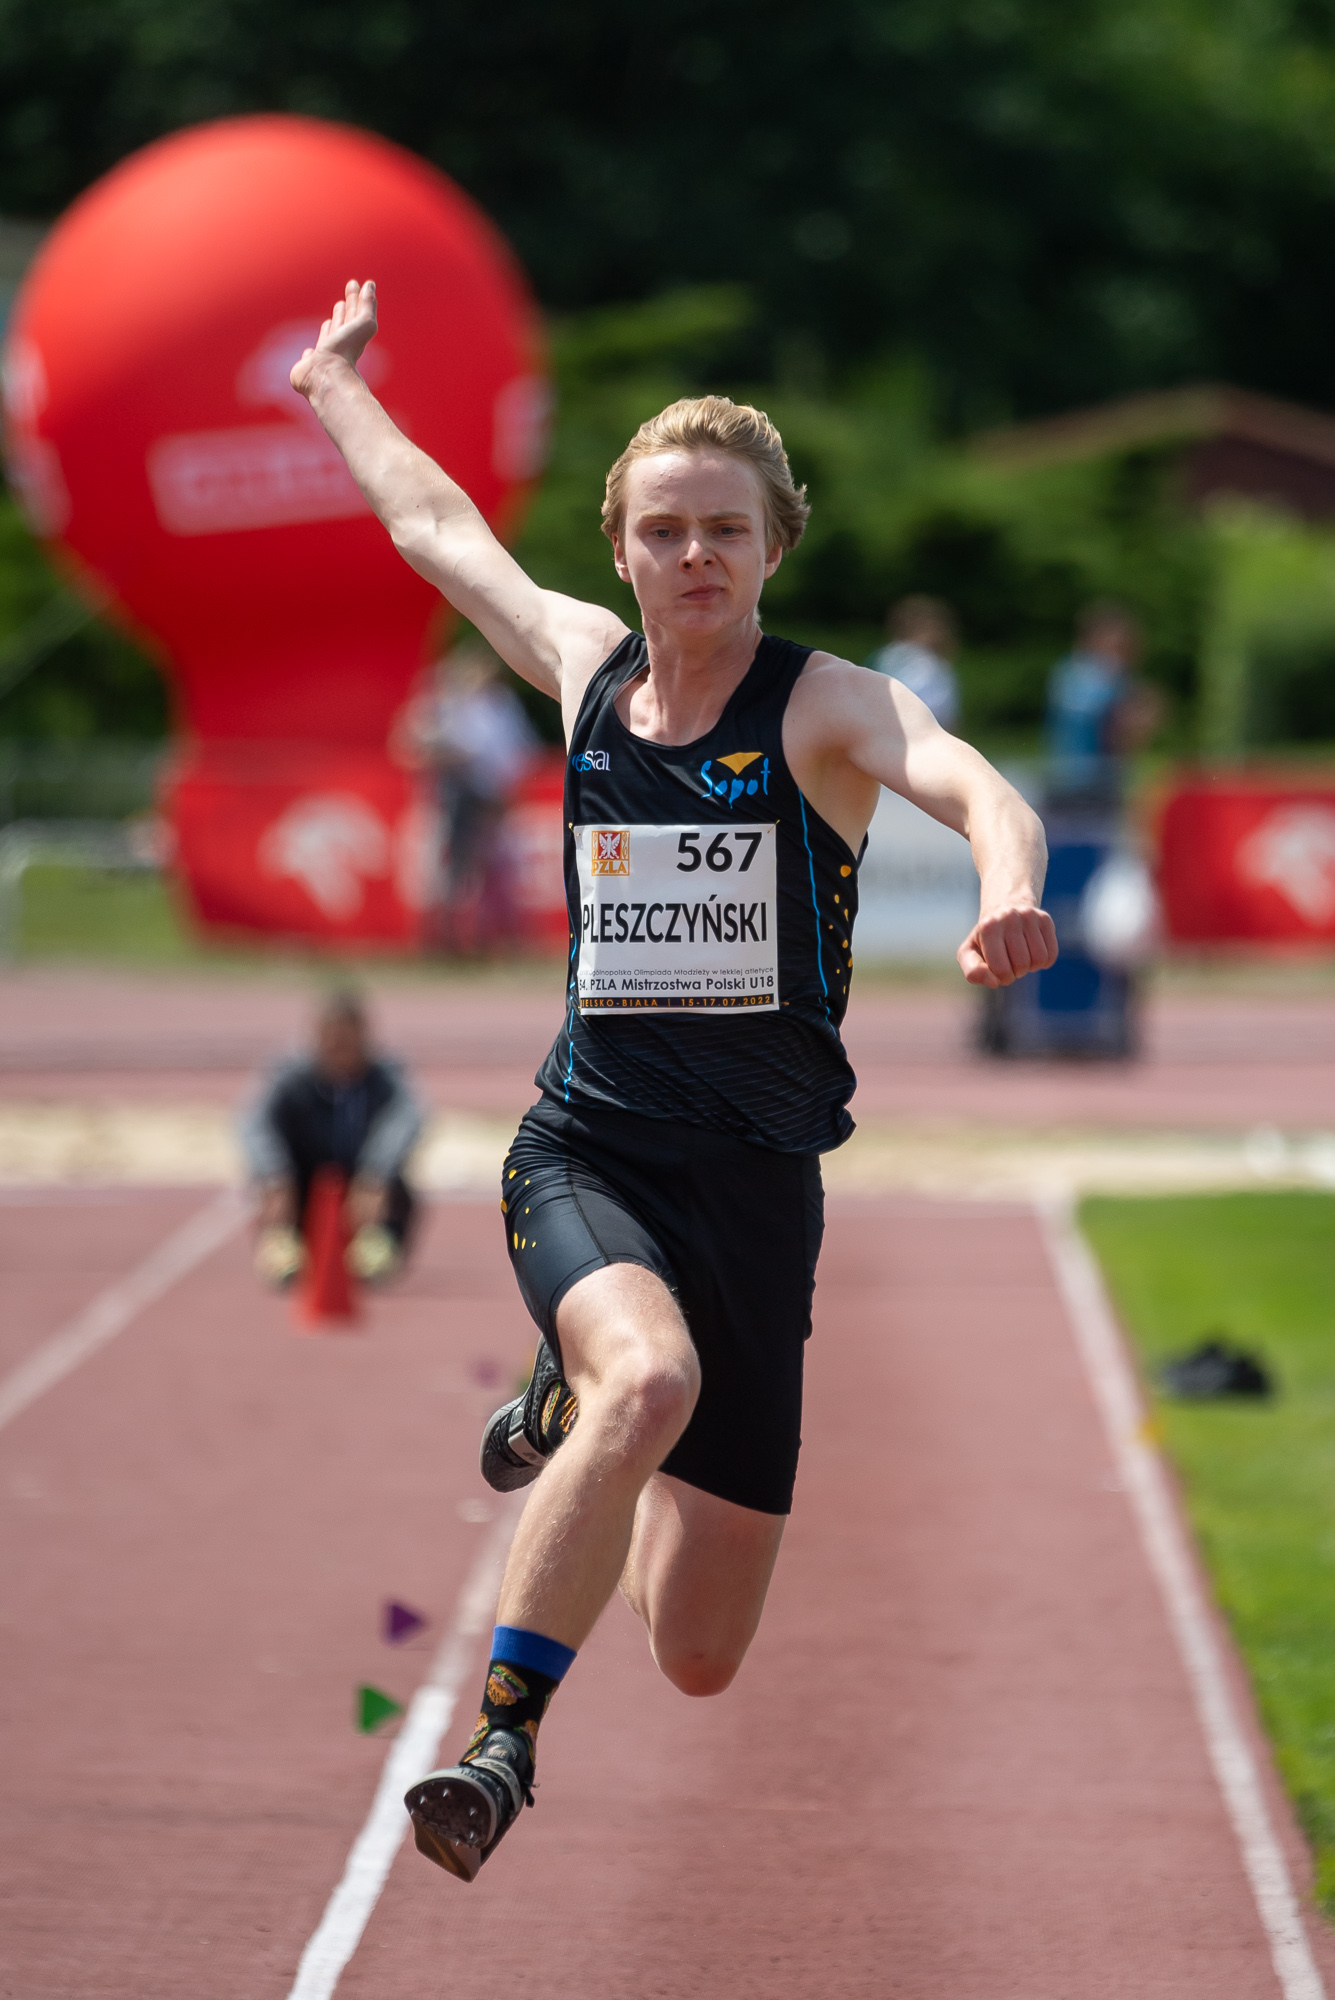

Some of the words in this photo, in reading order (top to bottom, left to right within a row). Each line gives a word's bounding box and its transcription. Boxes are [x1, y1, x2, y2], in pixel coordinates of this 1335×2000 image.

[700, 757, 771, 809] Sopot
[676, 832, 762, 872] 567
[592, 861, 627, 874] PZLA
[582, 894, 767, 944] PLESZCZYŃSKI
[634, 968, 672, 976] Olimpiada
[674, 968, 710, 977] Młodzieży
[720, 968, 743, 976] lekkiej
[744, 967, 774, 975] atletyce
[590, 979, 617, 991] PZLA
[621, 978, 702, 991] Mistrzostwa
[706, 977, 746, 991] Polski
[750, 975, 774, 989] U18
[681, 995, 771, 1007] 15-17.07.2022
